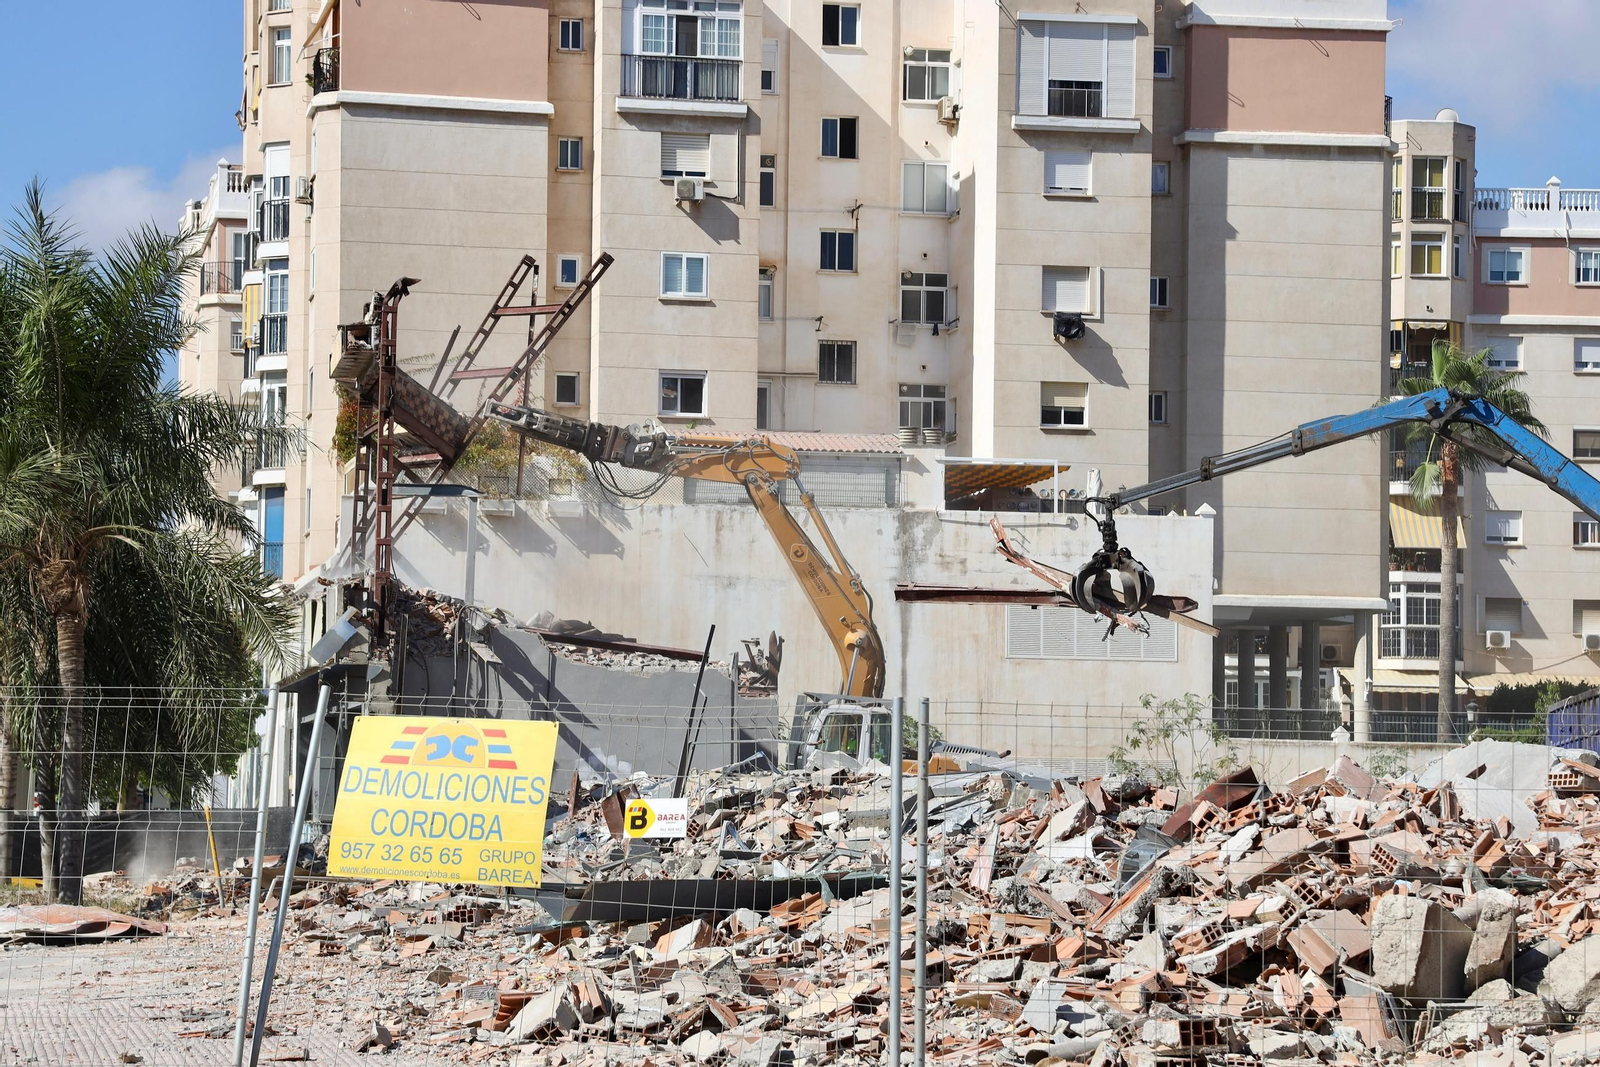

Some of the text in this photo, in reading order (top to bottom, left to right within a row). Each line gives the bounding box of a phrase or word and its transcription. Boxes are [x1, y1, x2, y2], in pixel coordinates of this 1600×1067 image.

[343, 765, 546, 805] DEMOLICIONES
[370, 808, 503, 842] CORDOBA
[657, 813, 686, 822] BAREA
[340, 841, 463, 865] 957 32 65 65
[479, 848, 536, 865] GRUPO
[339, 865, 461, 880] www.demolicionescordoba.es
[477, 867, 535, 884] BAREA
